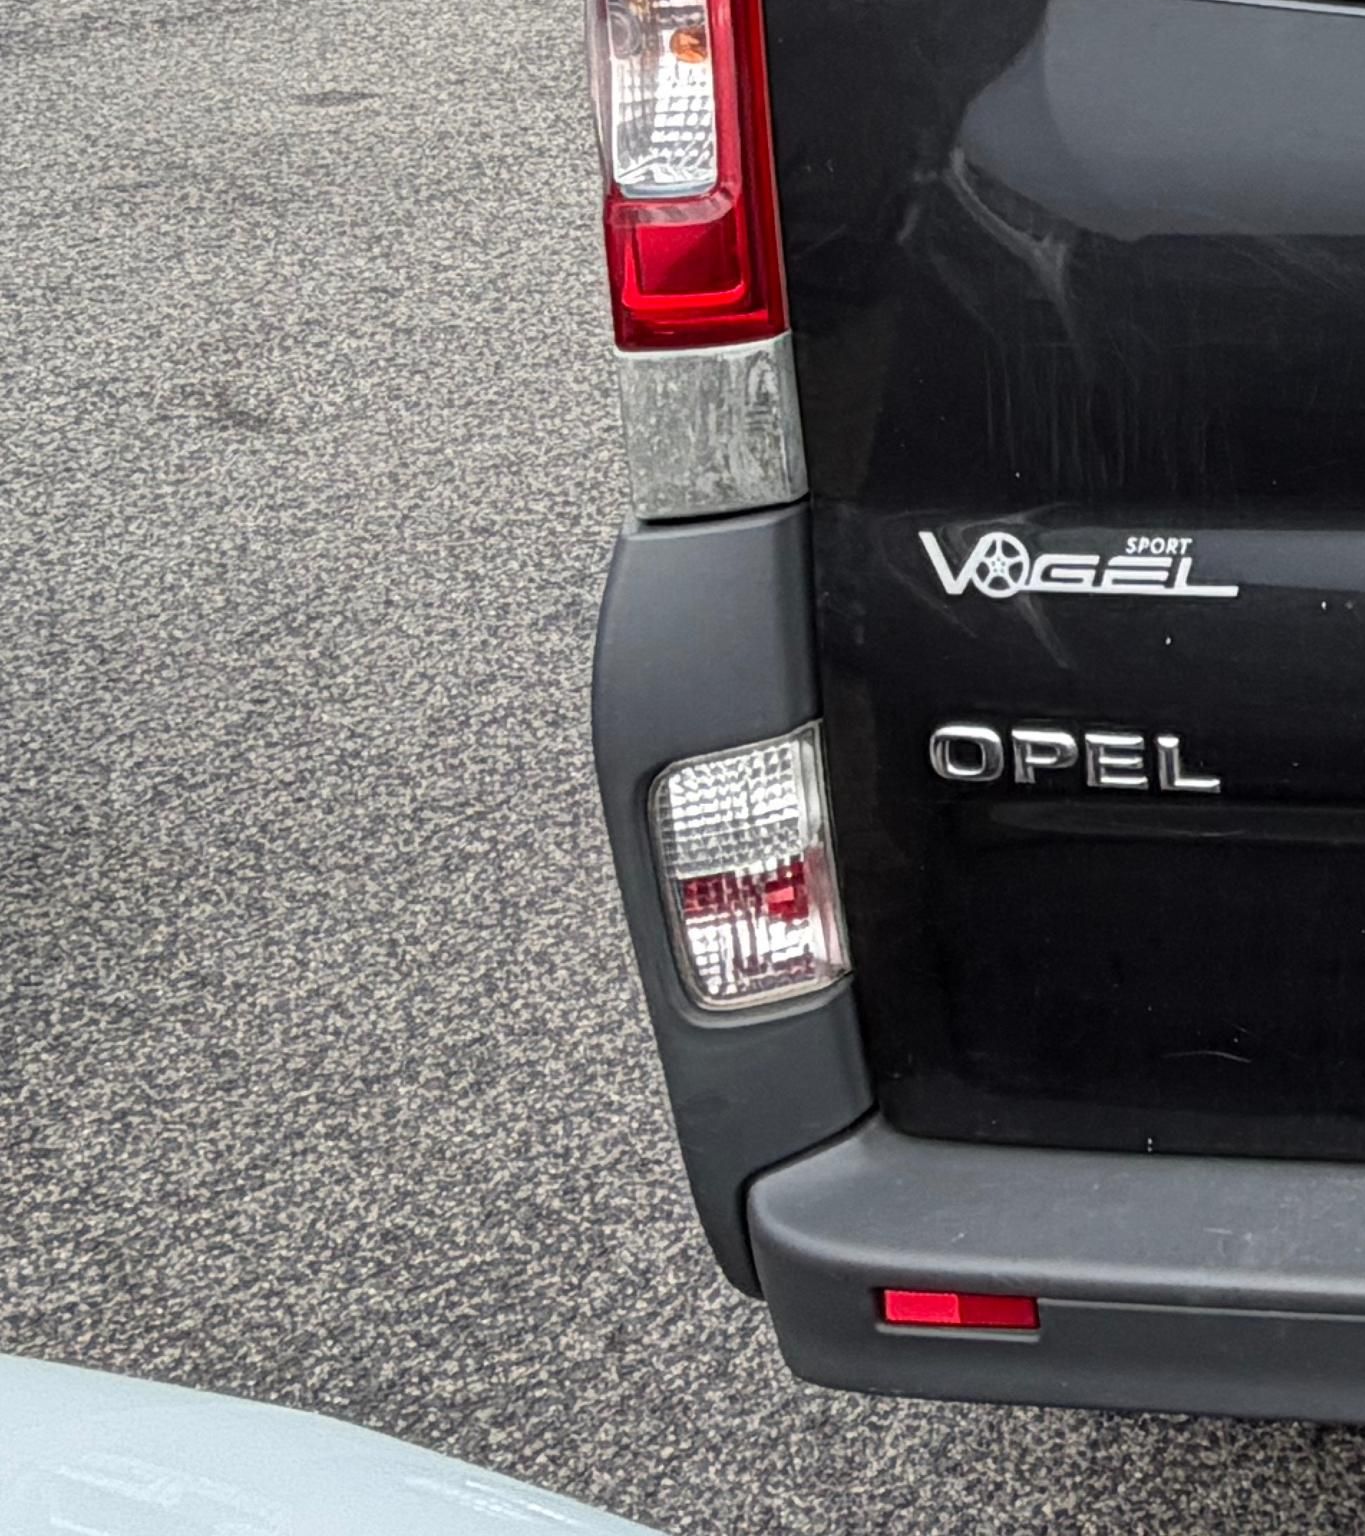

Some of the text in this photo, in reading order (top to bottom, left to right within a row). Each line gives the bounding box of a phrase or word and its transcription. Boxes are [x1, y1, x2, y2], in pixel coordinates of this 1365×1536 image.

[918, 531, 1240, 599] VOGEL
[1125, 536, 1193, 555] SPORT
[929, 724, 1222, 794] OPEL
